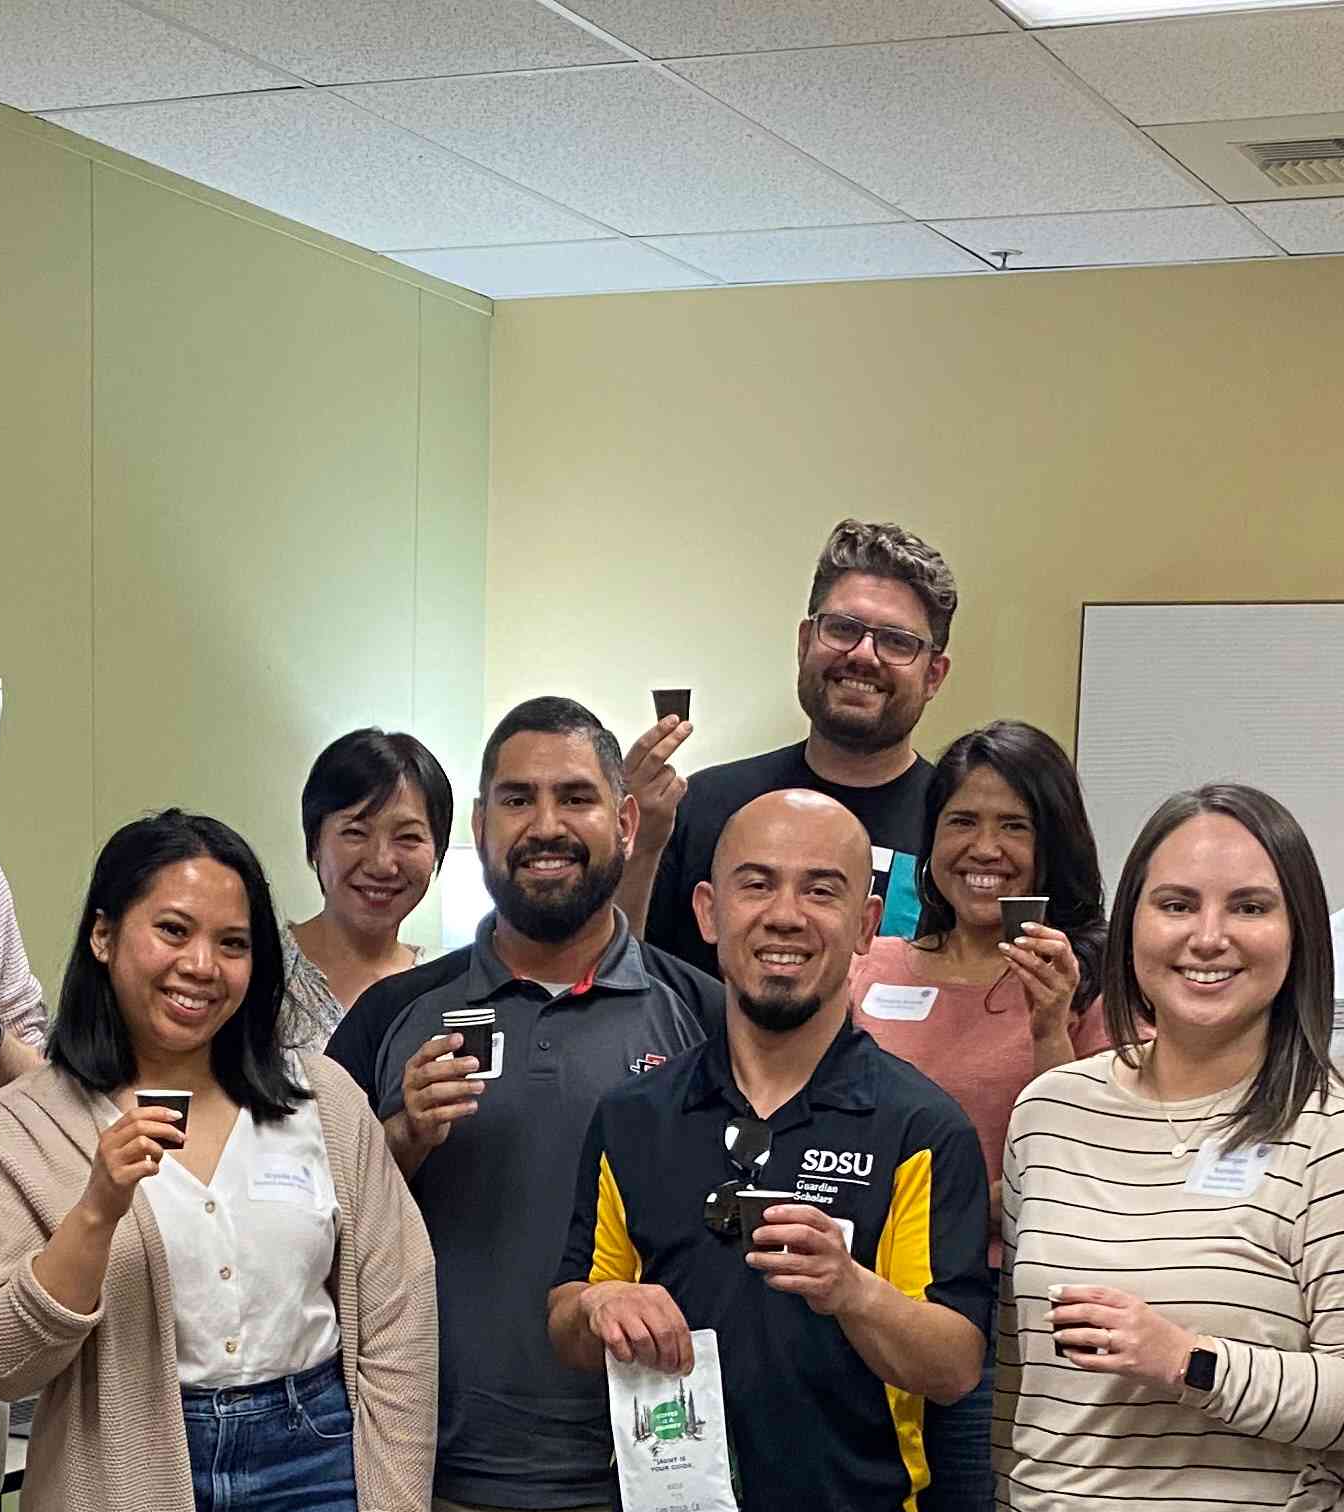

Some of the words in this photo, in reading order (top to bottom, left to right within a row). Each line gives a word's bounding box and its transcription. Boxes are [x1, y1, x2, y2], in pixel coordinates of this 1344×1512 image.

[801, 1149, 873, 1177] SDSU
[796, 1180, 839, 1193] Guardian
[793, 1191, 834, 1204] Scholars
